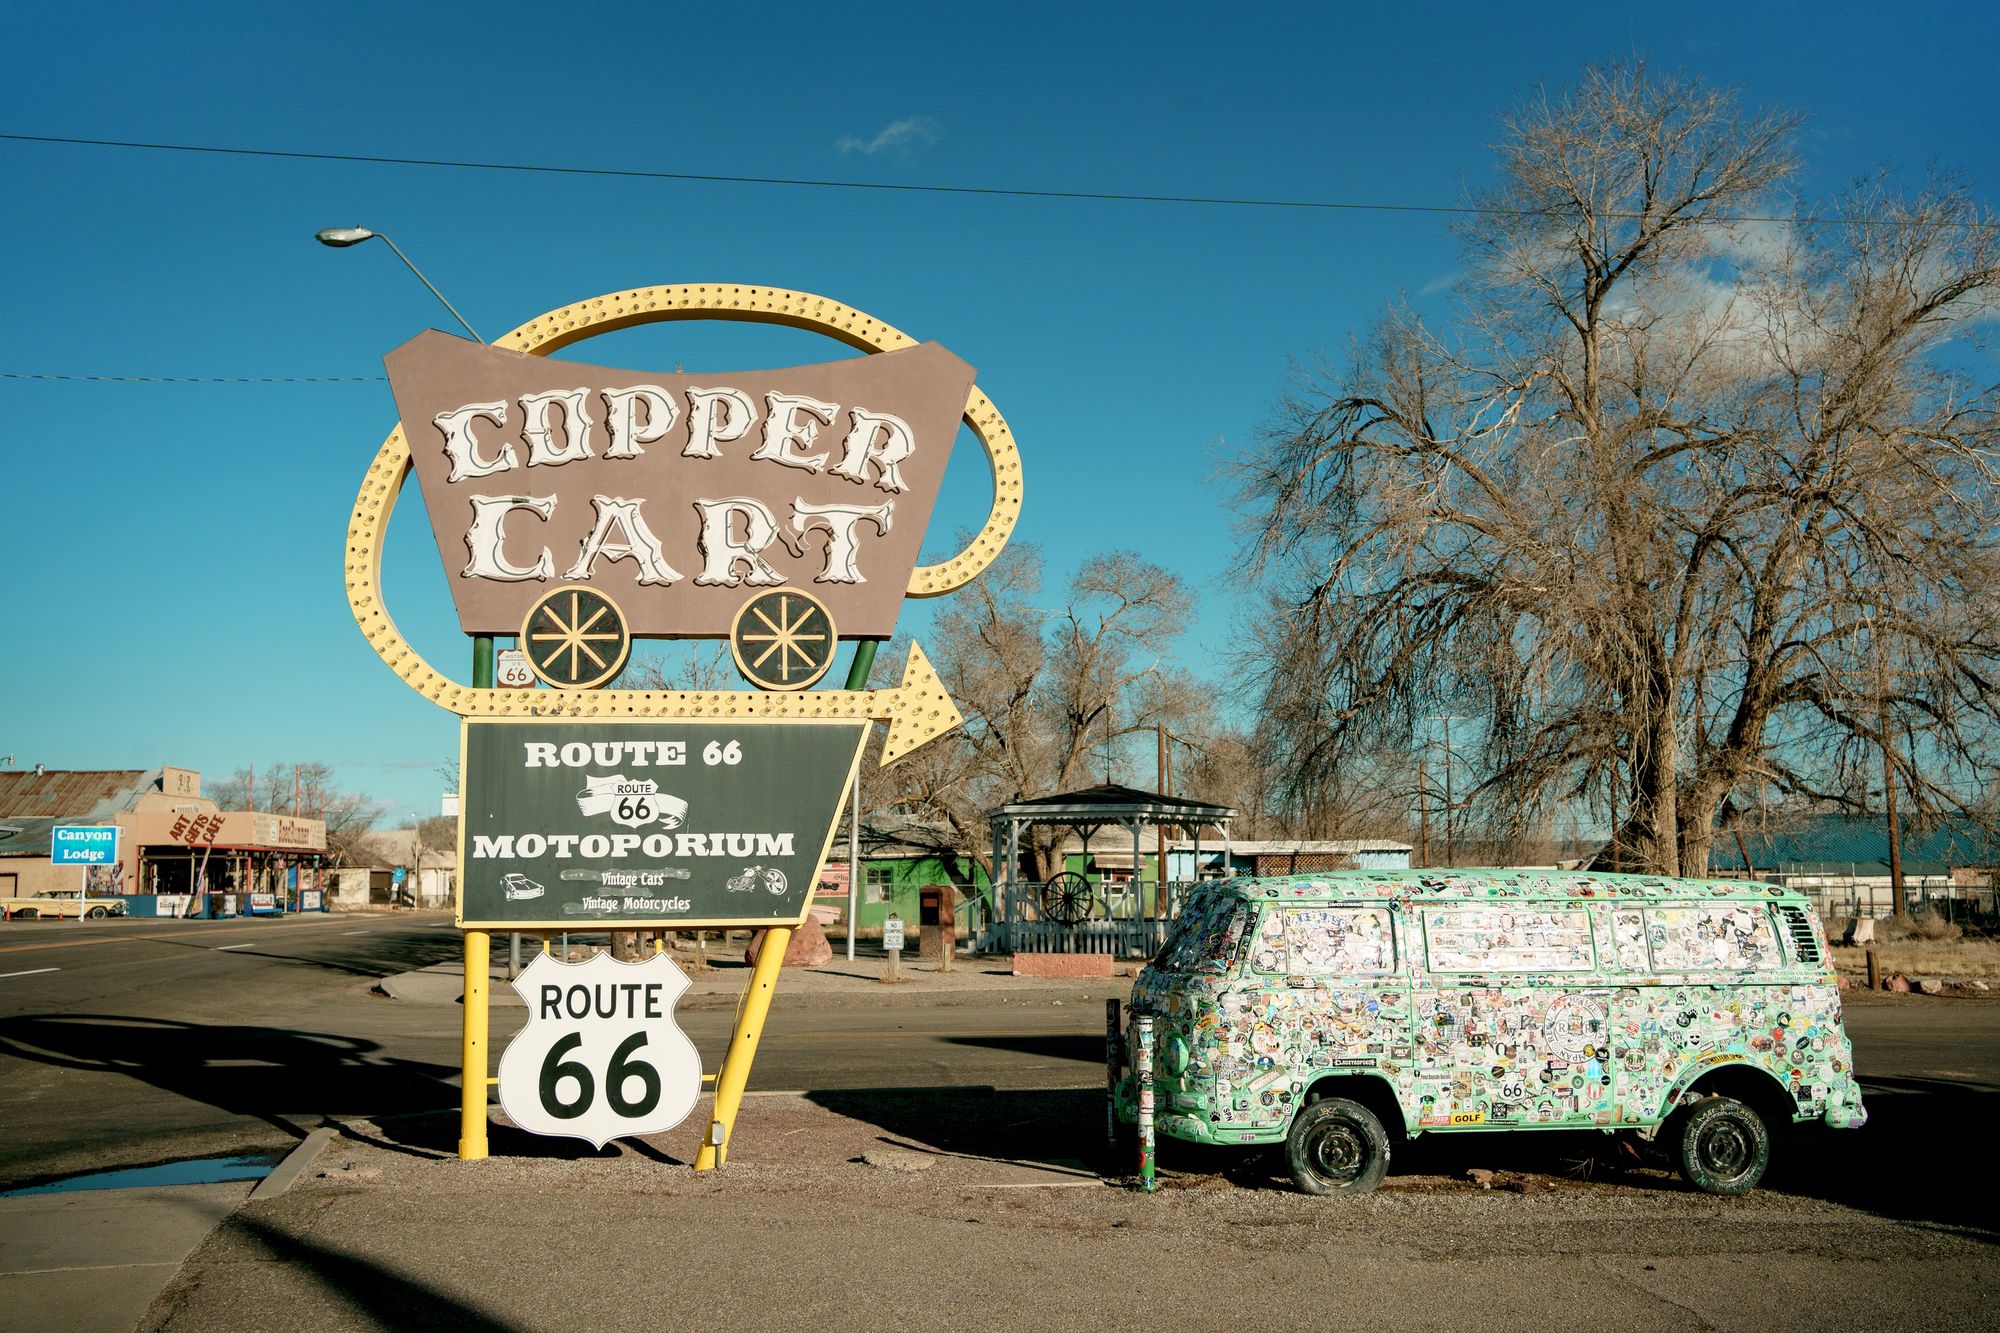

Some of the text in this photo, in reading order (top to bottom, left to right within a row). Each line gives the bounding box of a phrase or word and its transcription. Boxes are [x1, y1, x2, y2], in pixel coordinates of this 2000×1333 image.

[432, 384, 917, 494] COPPER
[460, 493, 896, 586] CART
[506, 668, 527, 682] 66
[524, 739, 743, 768] ROUTE 66
[617, 784, 652, 794] ROUTE
[618, 796, 651, 820] 66
[57, 829, 112, 842] Canyon
[169, 814, 191, 841] ART
[184, 814, 209, 844] GIFTS
[202, 814, 226, 842] CAFE
[63, 848, 105, 861] Lodge
[473, 832, 795, 858] MOTOPORIUM
[601, 872, 664, 888] Vintage Cars
[582, 896, 691, 912] Vintage Motorcycles
[540, 984, 663, 1020] ROUTE
[538, 1030, 662, 1119] 66
[1504, 1083, 1522, 1097] 66
[1454, 1114, 1481, 1122] GOLF
